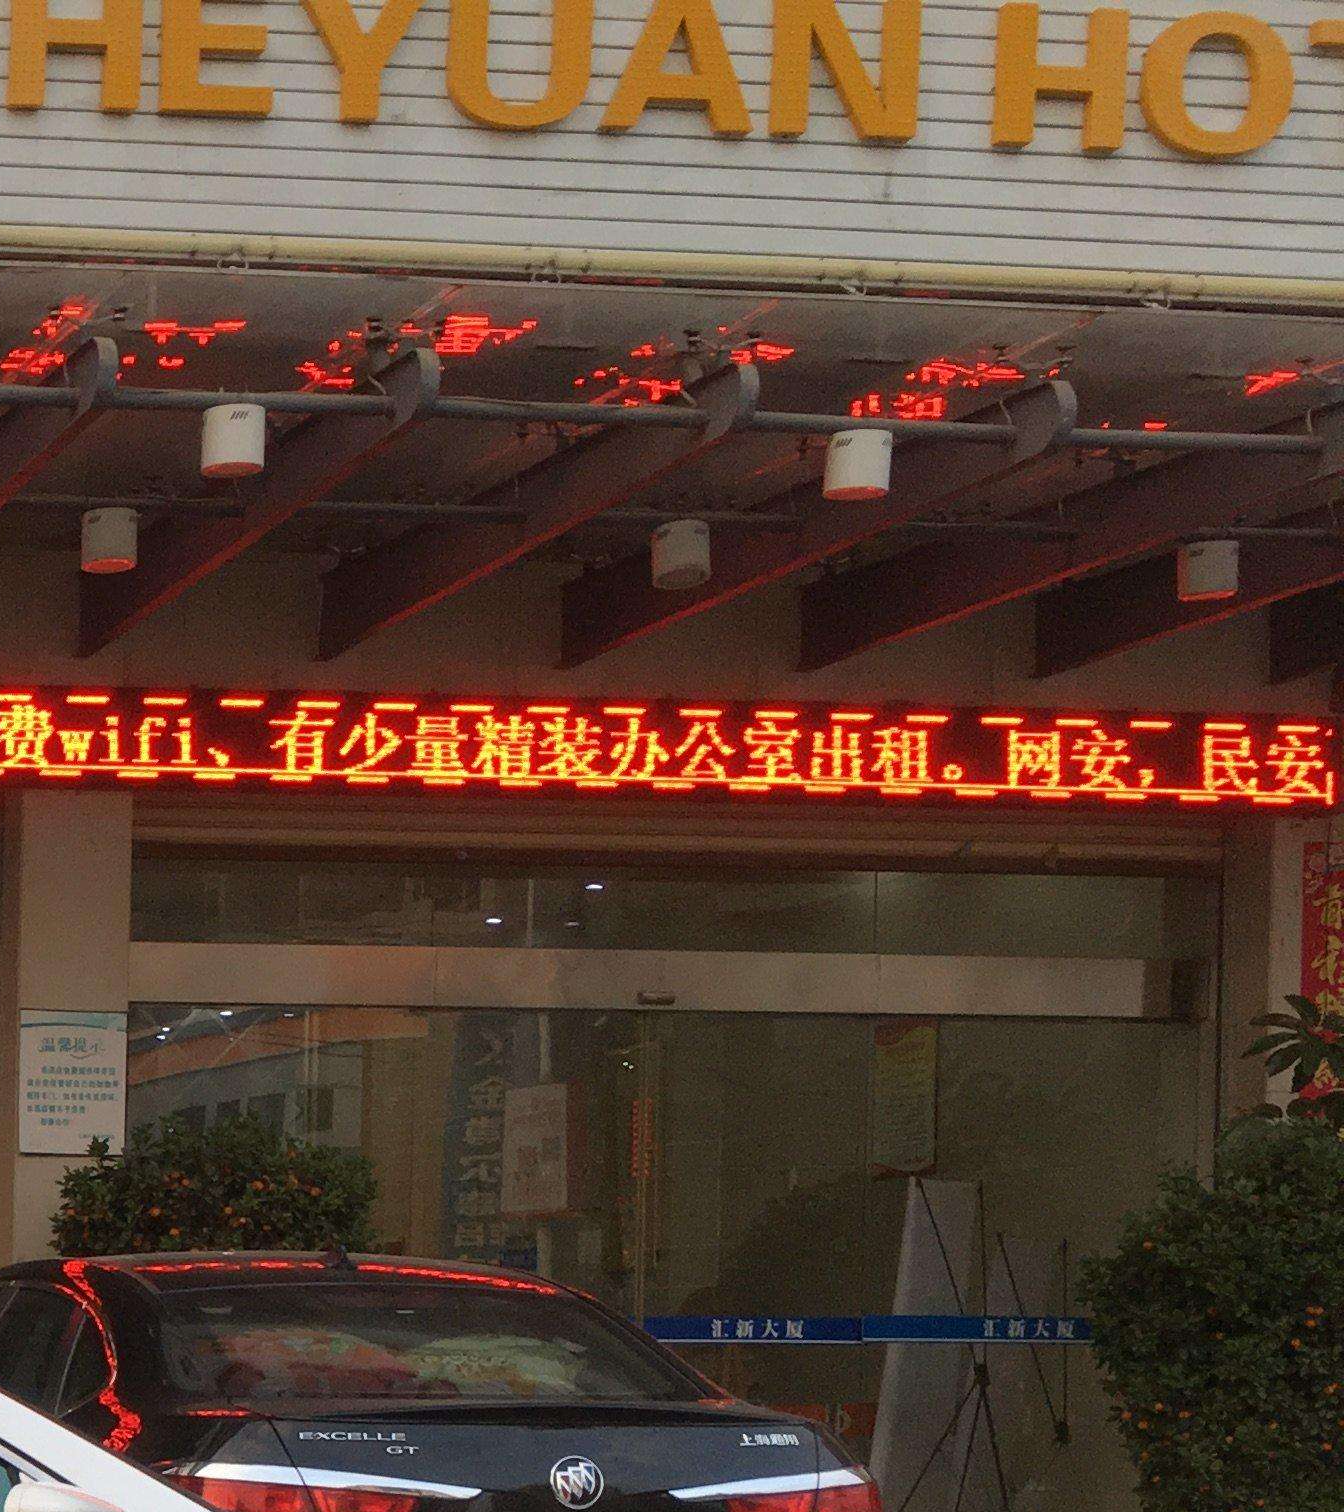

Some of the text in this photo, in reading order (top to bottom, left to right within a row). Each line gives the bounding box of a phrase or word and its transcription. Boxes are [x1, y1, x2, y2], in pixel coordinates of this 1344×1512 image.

[5, 0, 1344, 160] HEYUAN HO
[710, 1317, 805, 1340] 汇新大厦
[983, 1318, 1076, 1339] 汇新大厦
[298, 1431, 406, 1442] EXCELLE
[386, 1445, 420, 1456] GT
